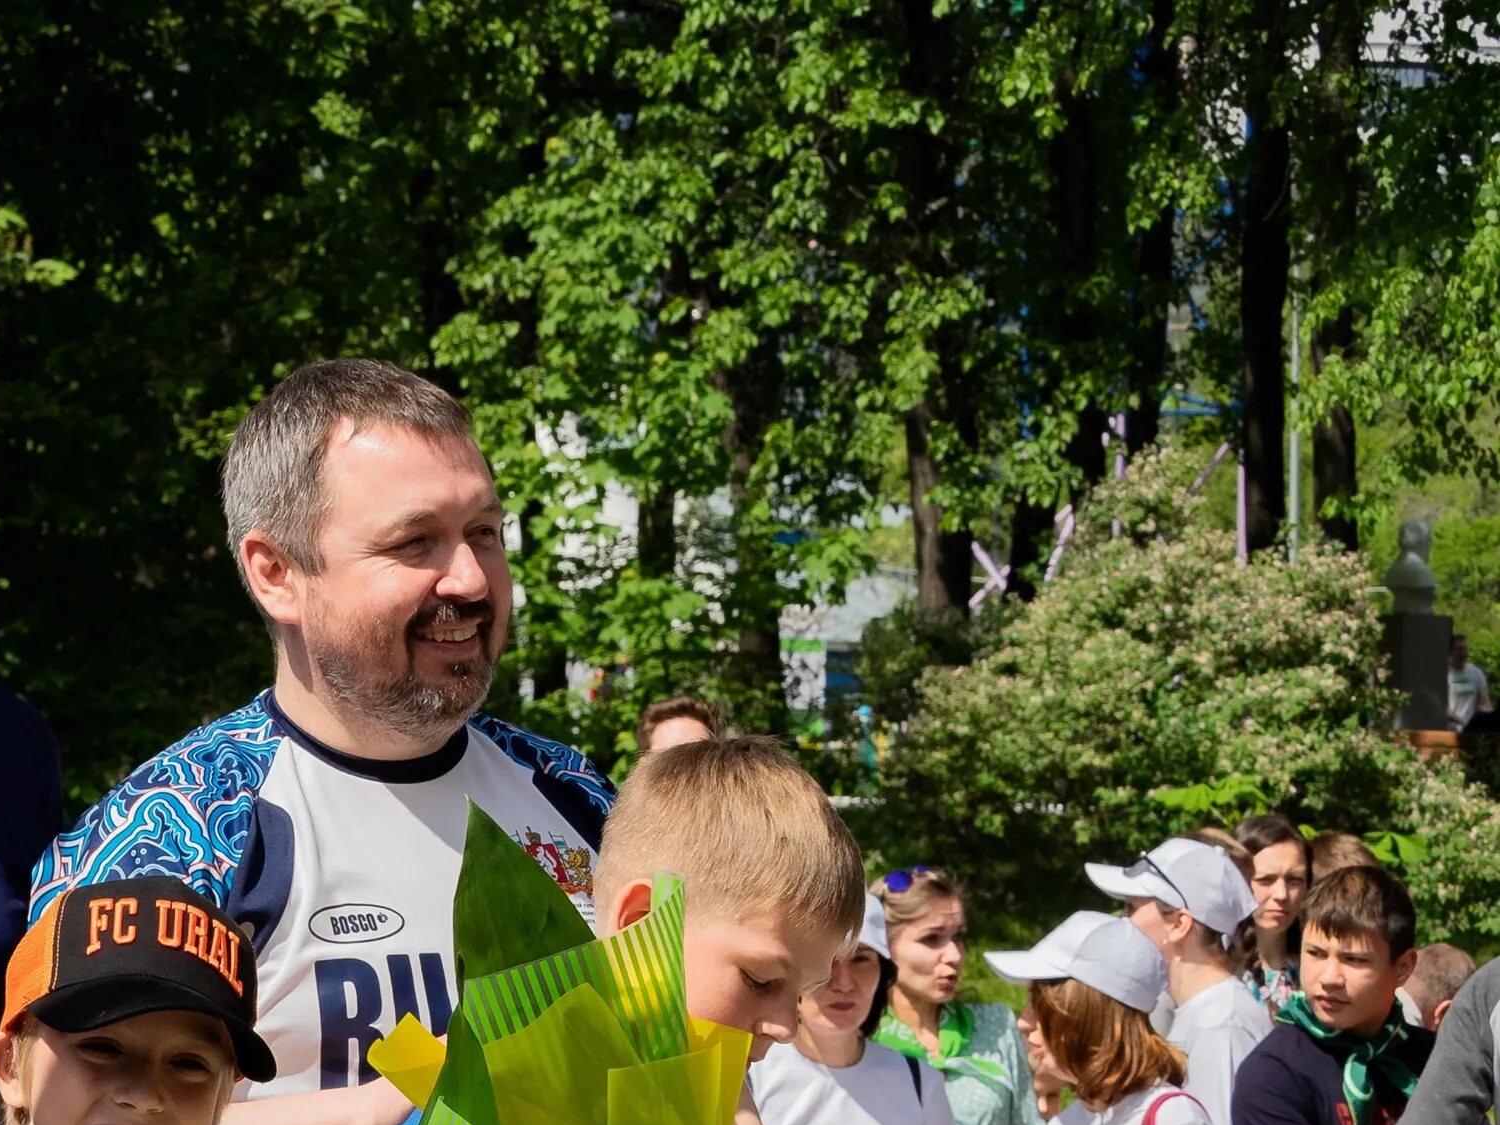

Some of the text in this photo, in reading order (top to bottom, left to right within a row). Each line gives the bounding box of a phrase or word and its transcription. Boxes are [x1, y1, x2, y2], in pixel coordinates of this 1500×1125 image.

[86, 897, 244, 998] FC URAL
[329, 914, 380, 935] BOSCO
